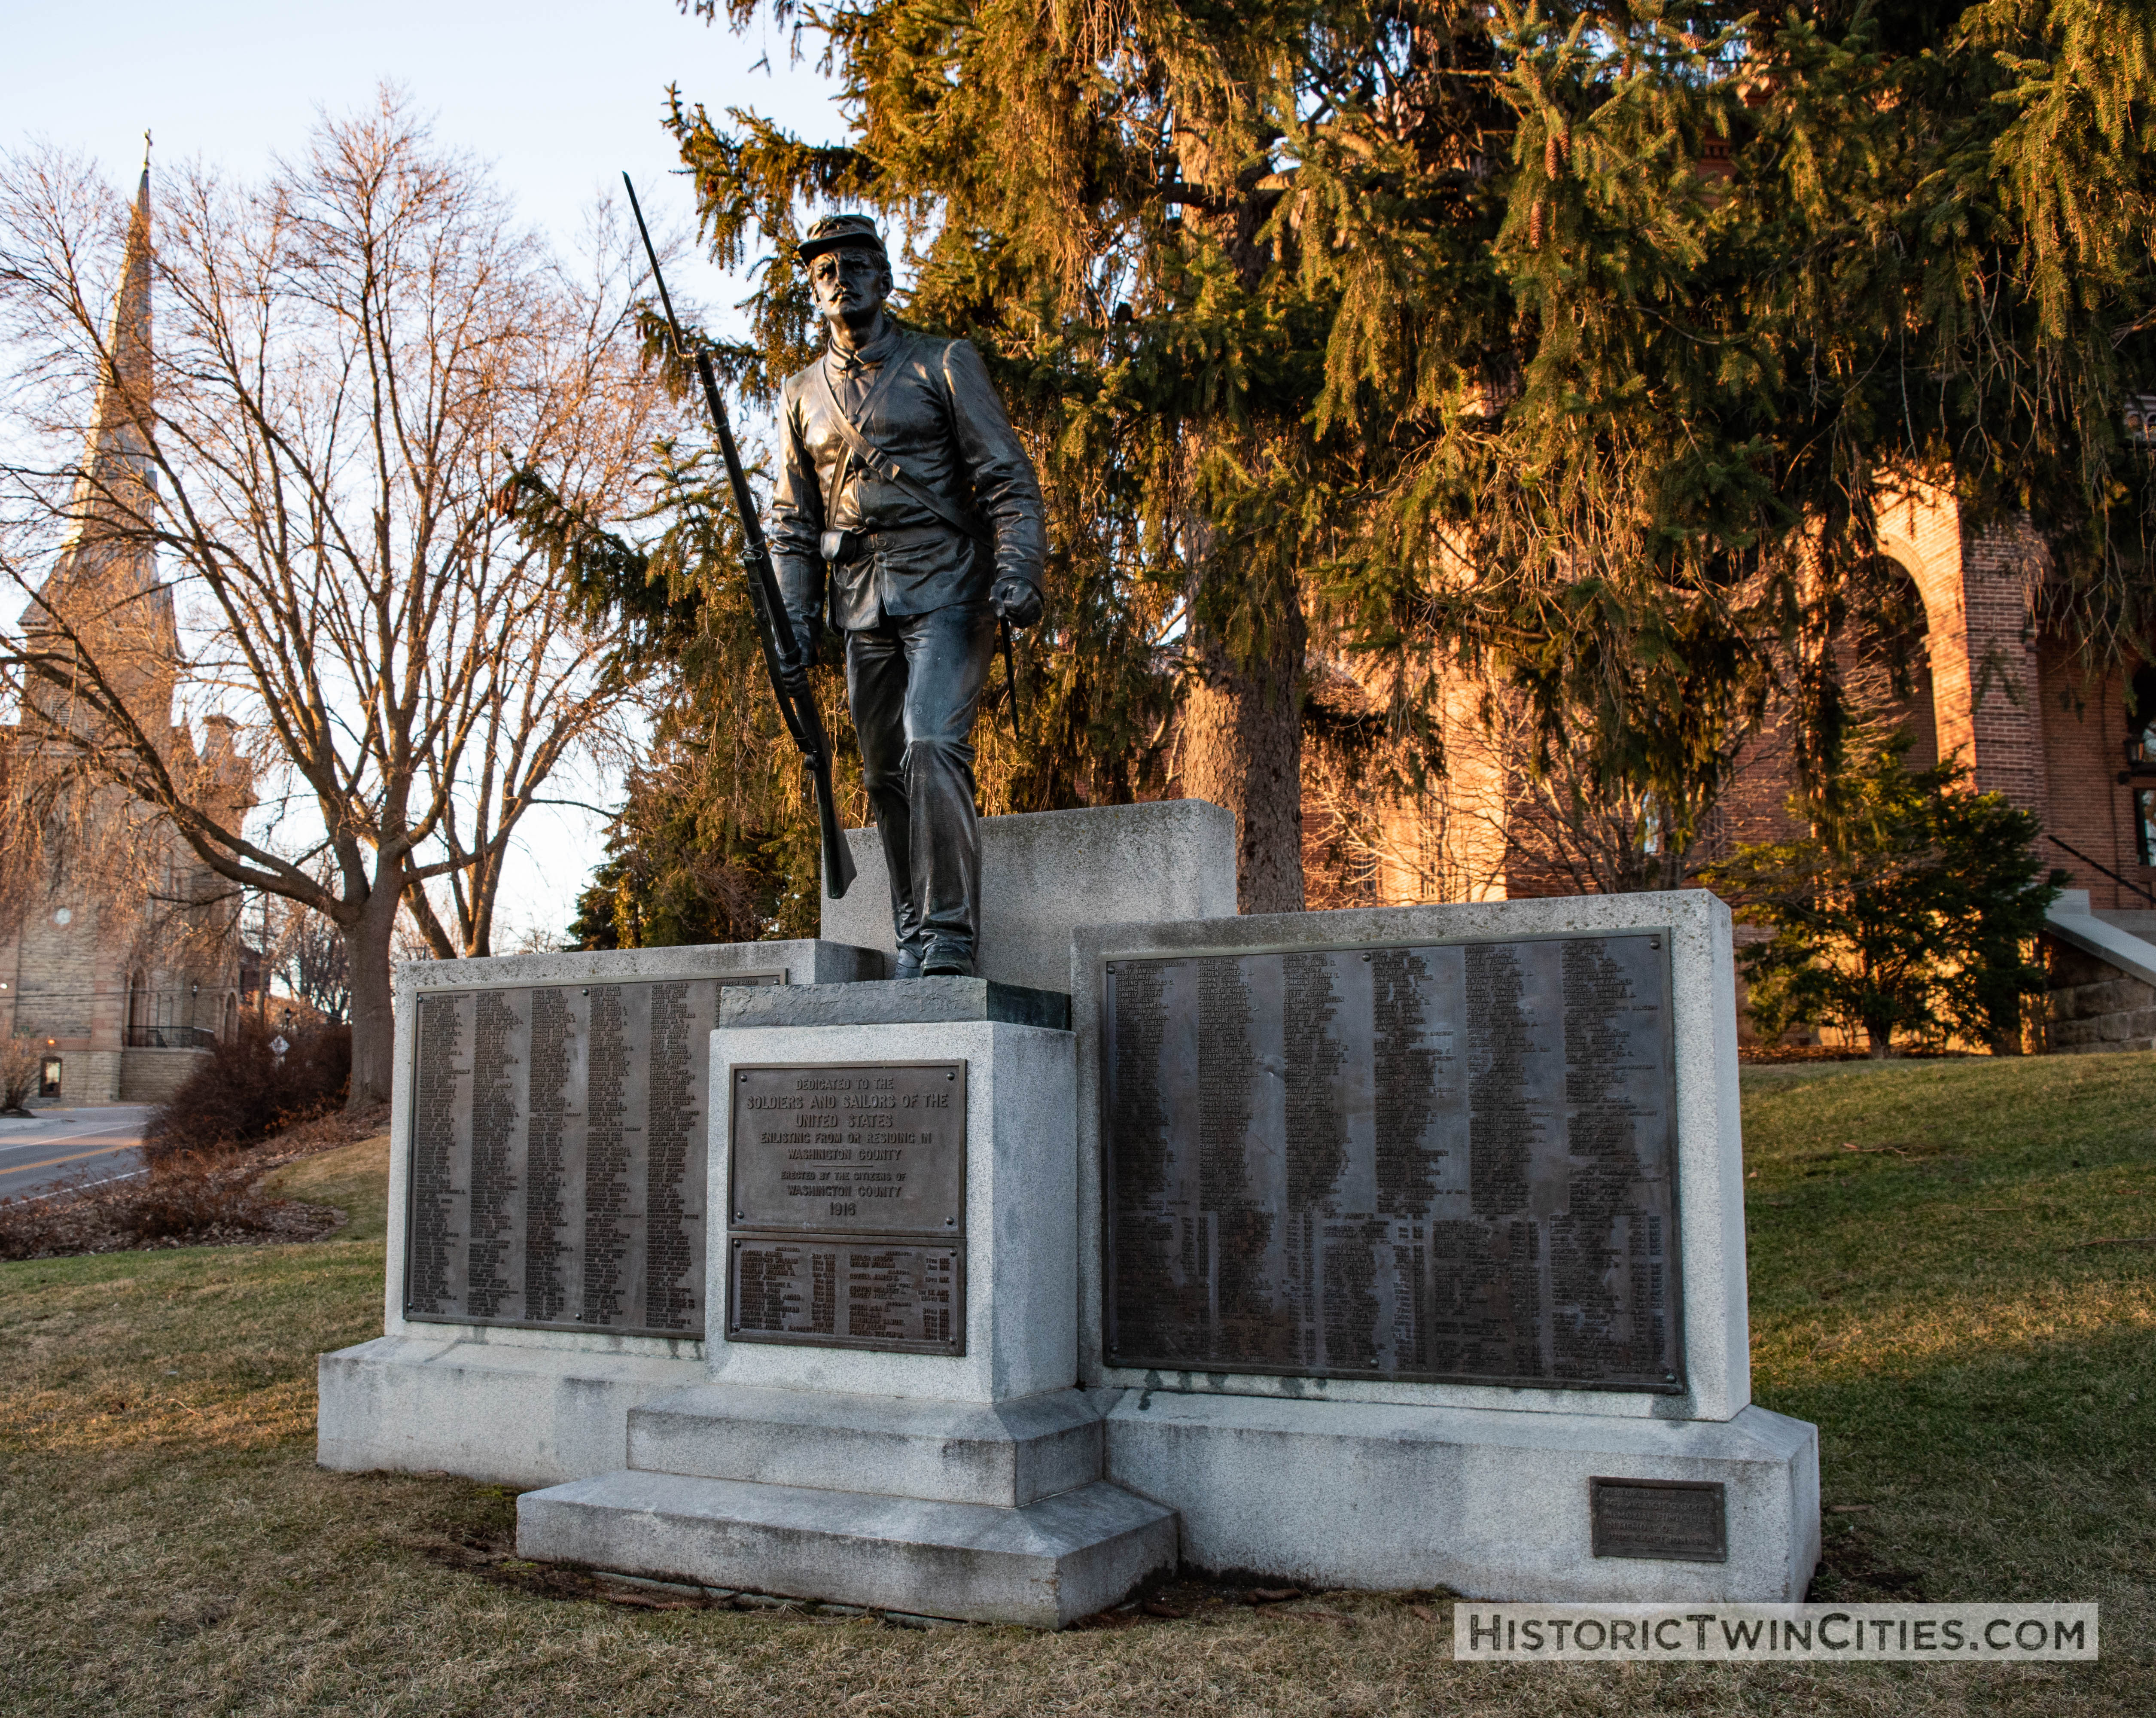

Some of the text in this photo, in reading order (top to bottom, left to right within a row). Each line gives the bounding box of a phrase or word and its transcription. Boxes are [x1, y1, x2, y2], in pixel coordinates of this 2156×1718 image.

[868, 533, 887, 548] US
[796, 1078, 893, 1090] DEDICATED TO THE
[747, 1094, 947, 1109] SOLDIERS AND SAILORS OF THE
[796, 1114, 892, 1127] UNITED STATES
[760, 1133, 932, 1143] ENLISTING FROM OR RESIDING IN
[788, 1149, 901, 1160] WASHINGTON COUNTY
[781, 1172, 815, 1180] ERECTED
[820, 1172, 831, 1180] BY
[834, 1172, 849, 1180] THE
[788, 1185, 901, 1197] WASHINGTON COUNTY
[830, 1202, 856, 1215] 1916
